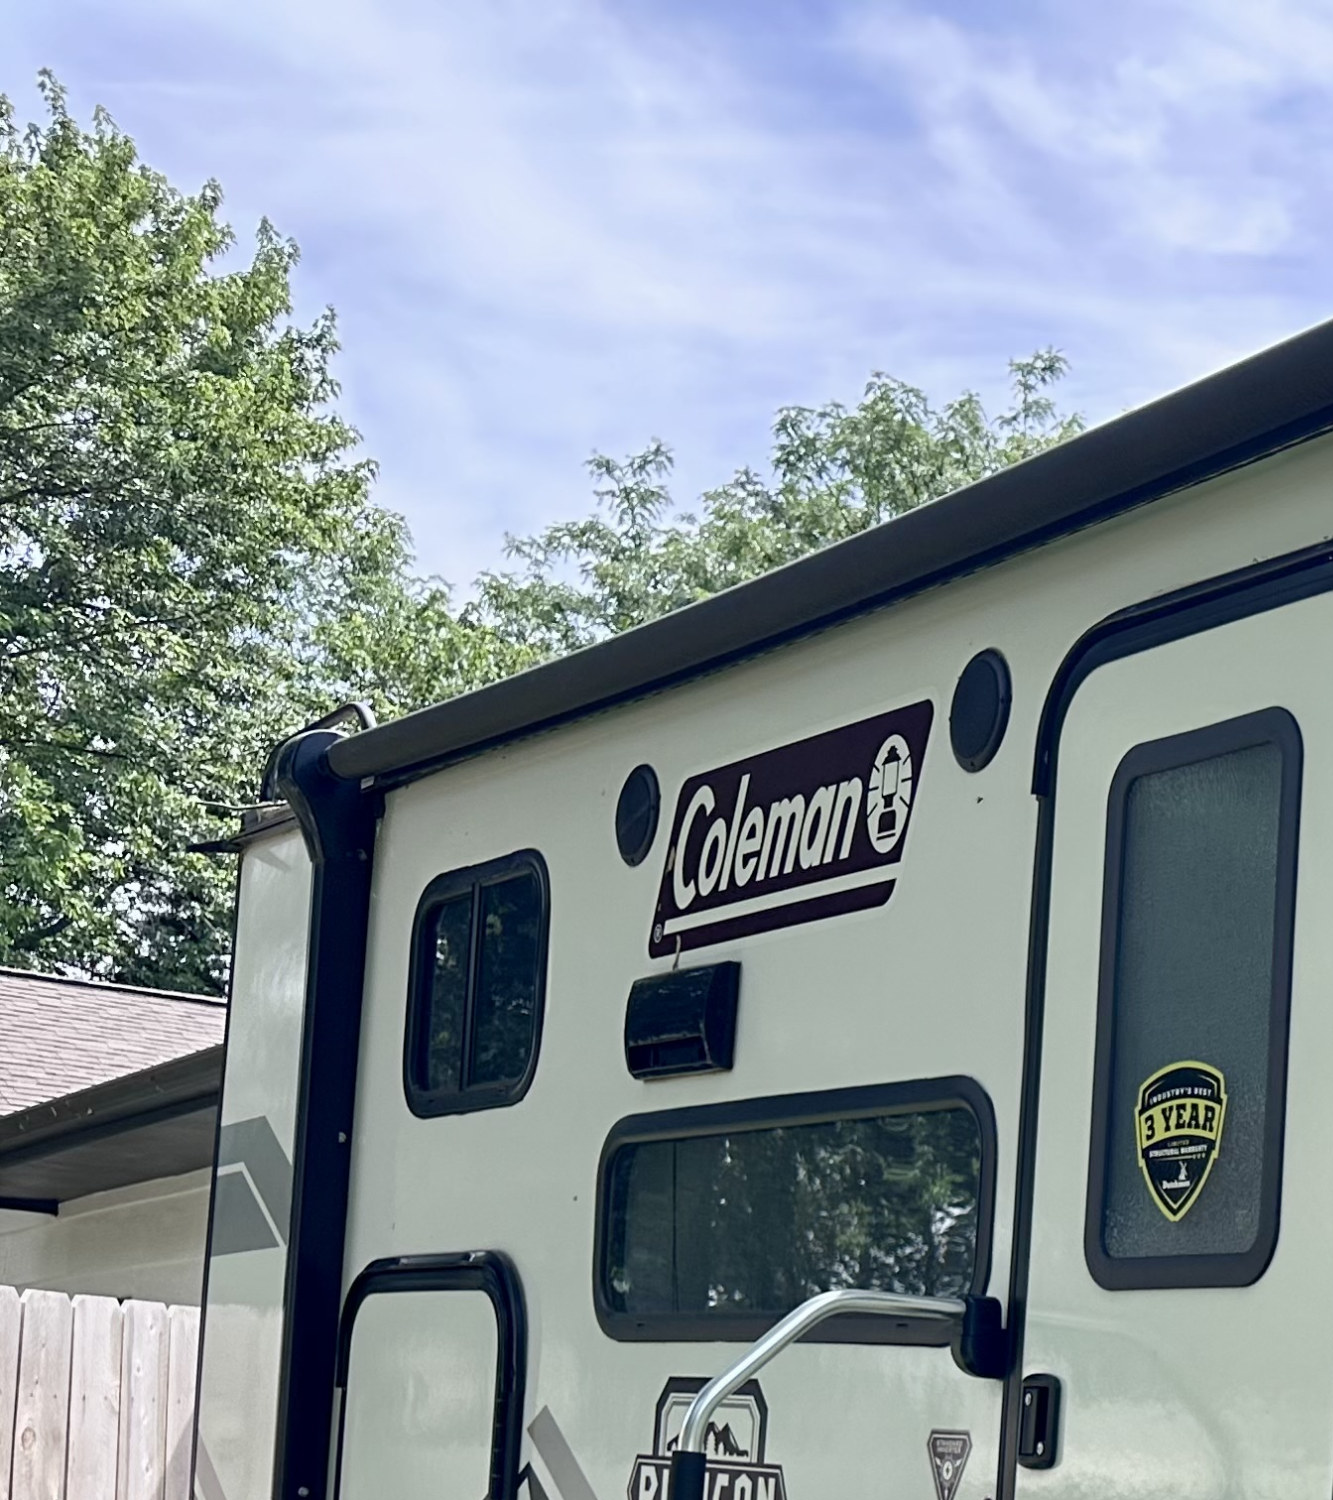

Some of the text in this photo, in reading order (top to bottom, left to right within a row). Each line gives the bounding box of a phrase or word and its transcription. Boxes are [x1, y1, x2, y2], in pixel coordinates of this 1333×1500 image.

[673, 774, 863, 910] Coleman
[1145, 1103, 1216, 1141] 3 YEAR
